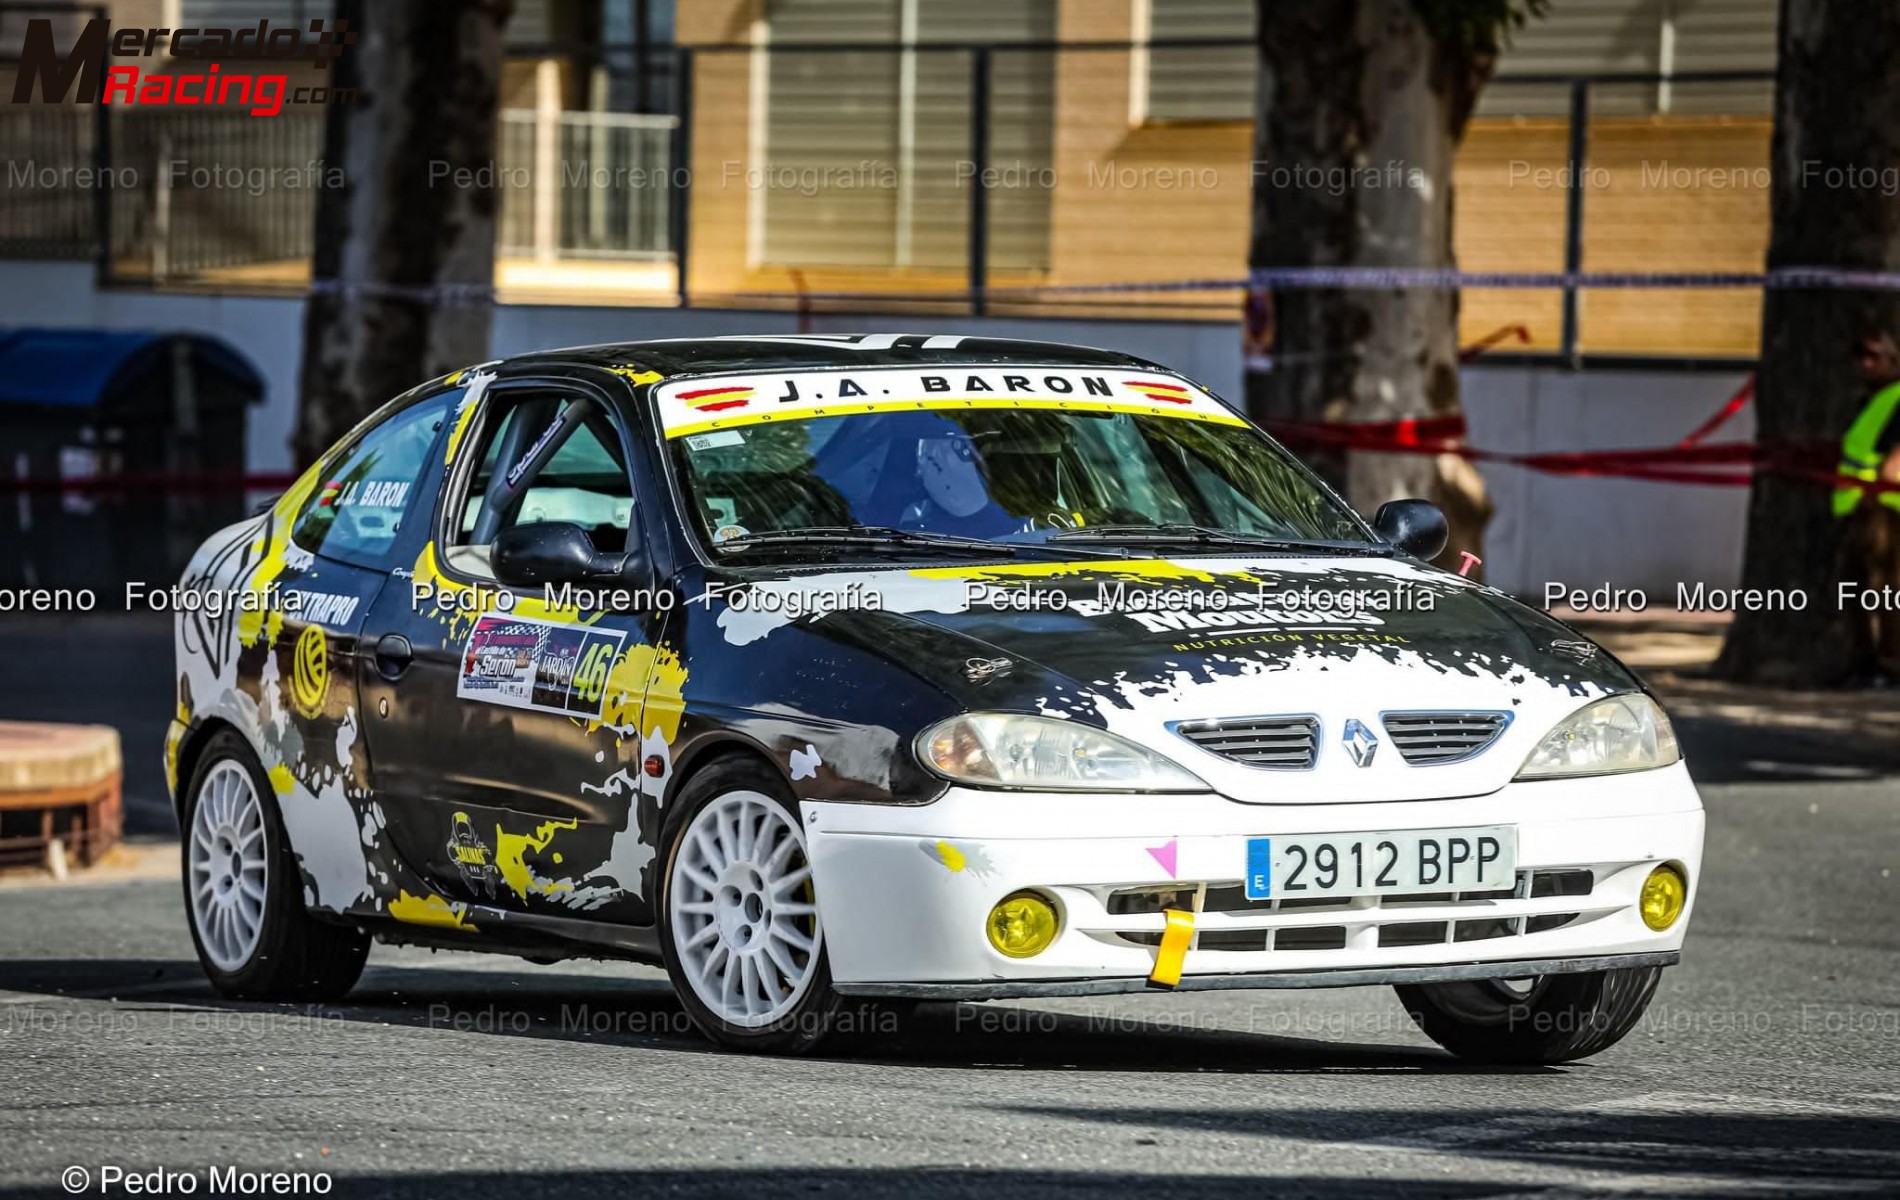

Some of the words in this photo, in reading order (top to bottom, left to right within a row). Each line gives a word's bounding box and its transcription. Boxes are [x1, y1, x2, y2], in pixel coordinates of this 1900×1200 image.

[920, 374, 1114, 397] BARON
[359, 481, 410, 507] BARON
[1310, 633, 1411, 644] VEGETAL
[573, 643, 614, 702] 46
[1284, 841, 1398, 890] 2912
[1419, 837, 1500, 884] BPP
[1254, 875, 1264, 888] E
